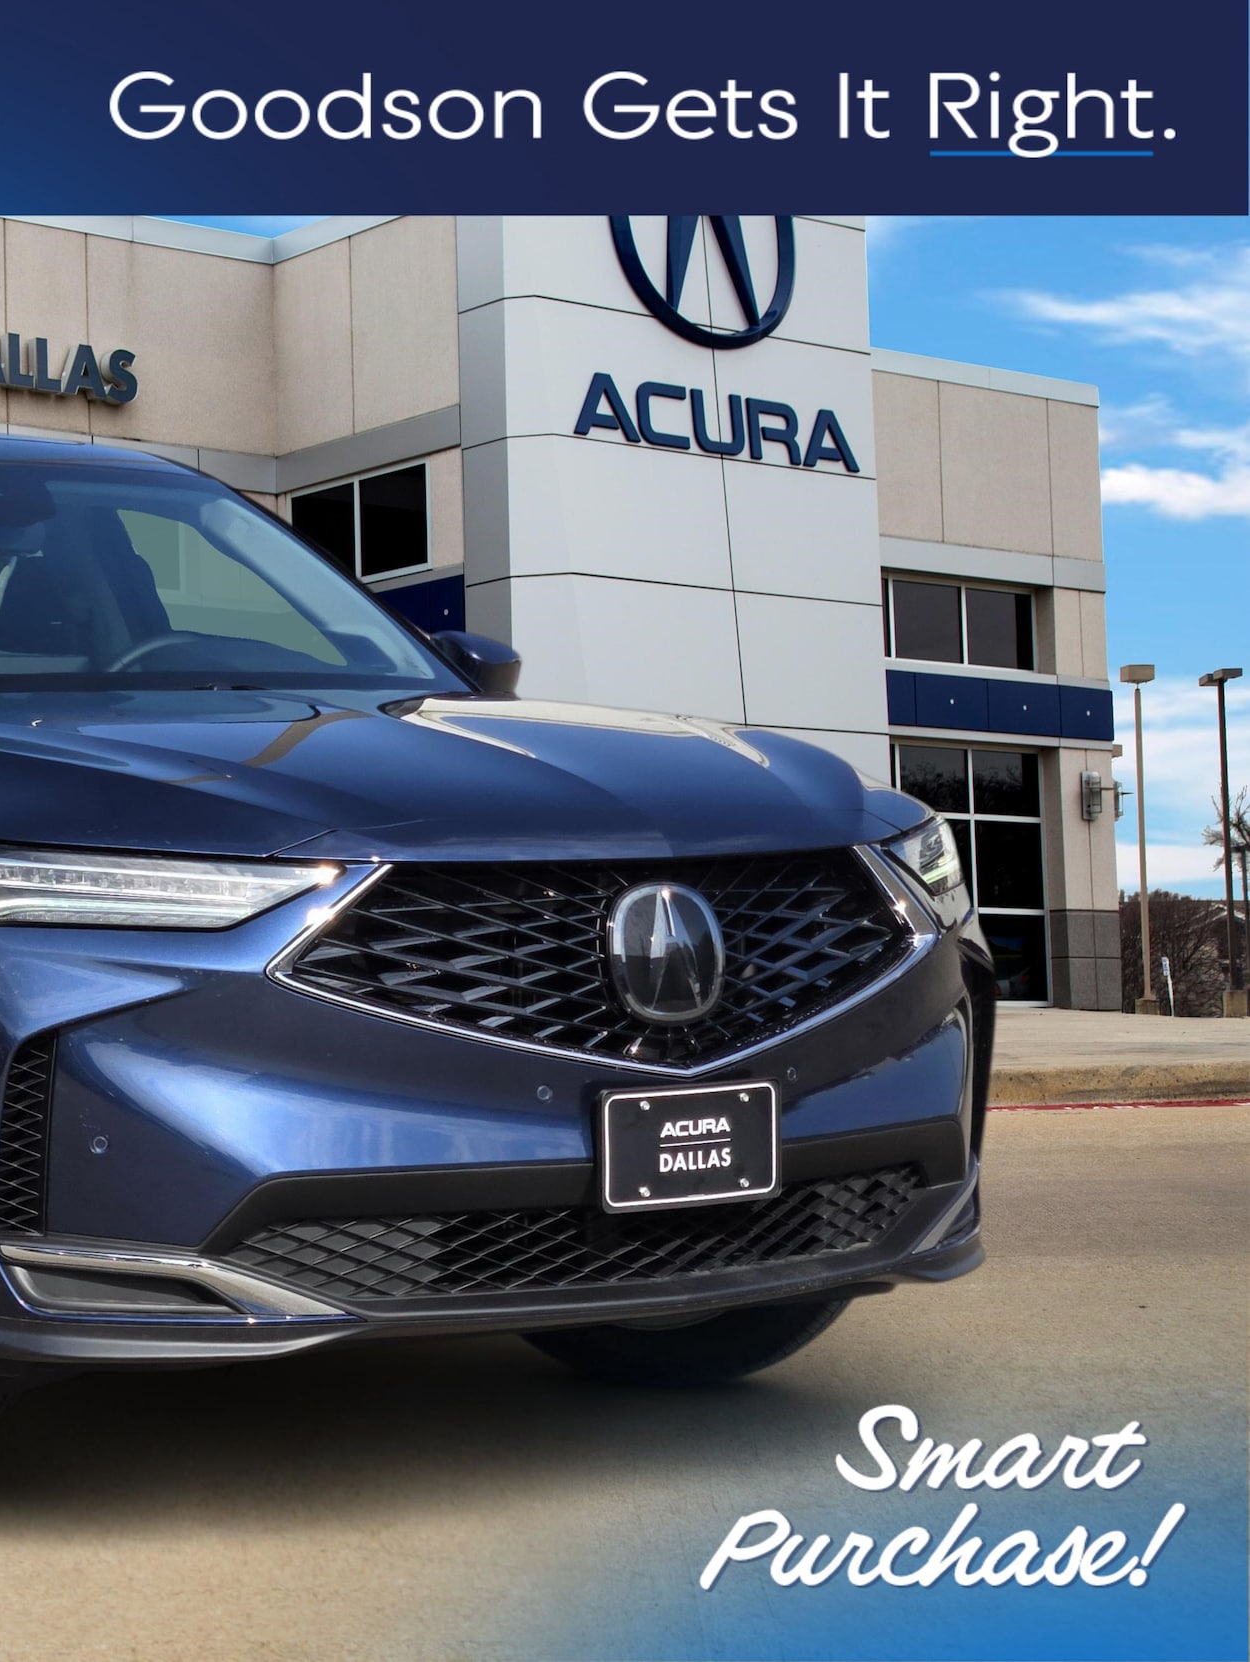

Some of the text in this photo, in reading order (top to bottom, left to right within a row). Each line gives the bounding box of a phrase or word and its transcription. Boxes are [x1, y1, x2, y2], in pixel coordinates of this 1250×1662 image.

[573, 372, 860, 473] ACURA
[659, 1117, 731, 1138] ACURA
[659, 1147, 732, 1173] DALLAS
